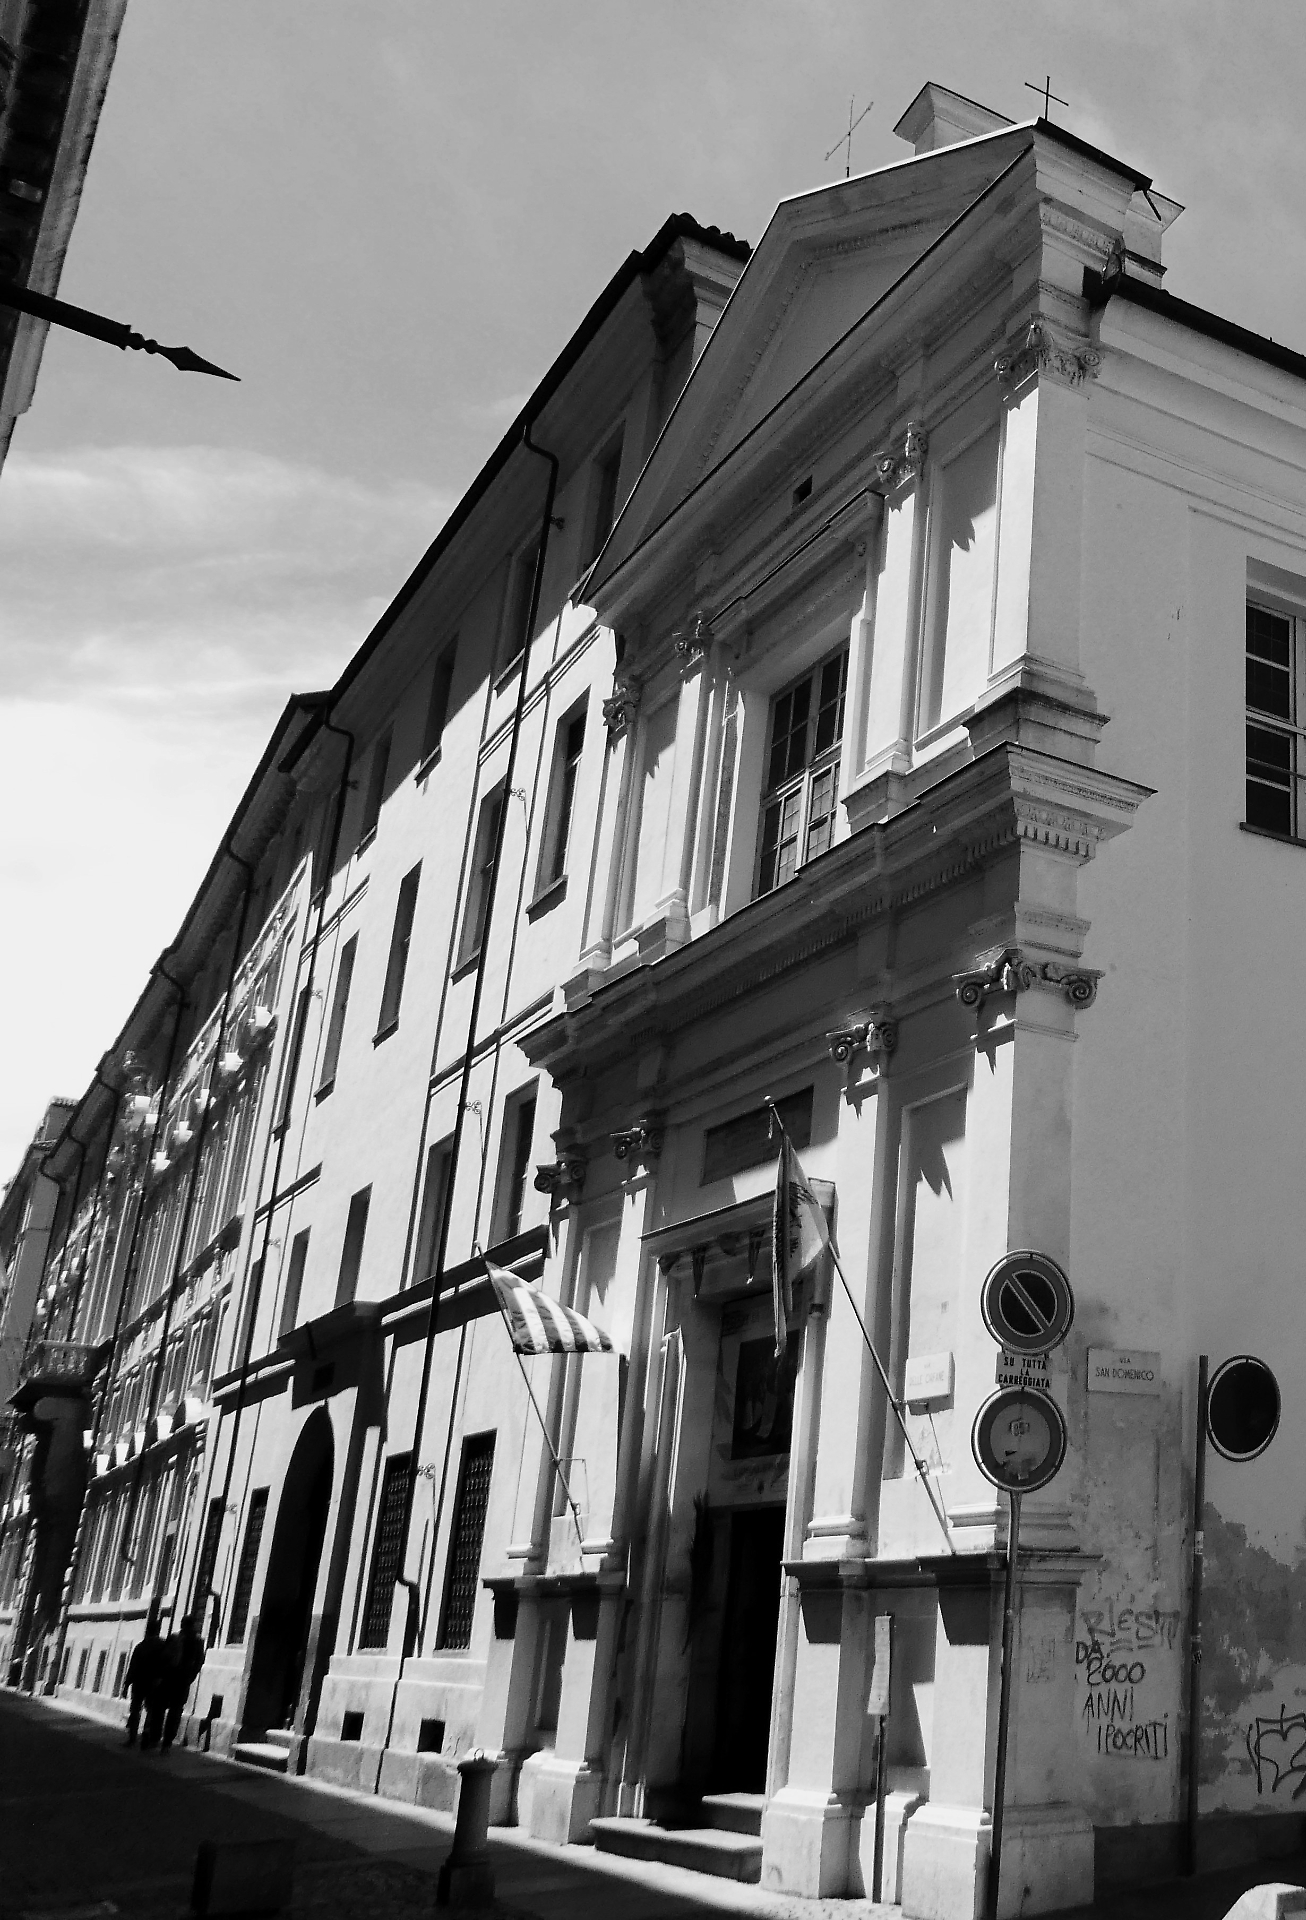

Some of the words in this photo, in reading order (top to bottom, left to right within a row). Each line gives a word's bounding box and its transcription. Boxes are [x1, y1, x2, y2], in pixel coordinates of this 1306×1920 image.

[1003, 1356, 1015, 1366] SU
[1022, 1357, 1047, 1370] TUTTA
[1020, 1368, 1030, 1377] LA
[1095, 1366, 1110, 1378] SAN
[1112, 1368, 1155, 1382] DOMENICO
[998, 1373, 1051, 1388] CARREGGIATA
[1087, 1656, 1146, 1686] 2000
[1082, 1686, 1134, 1724] ANNI
